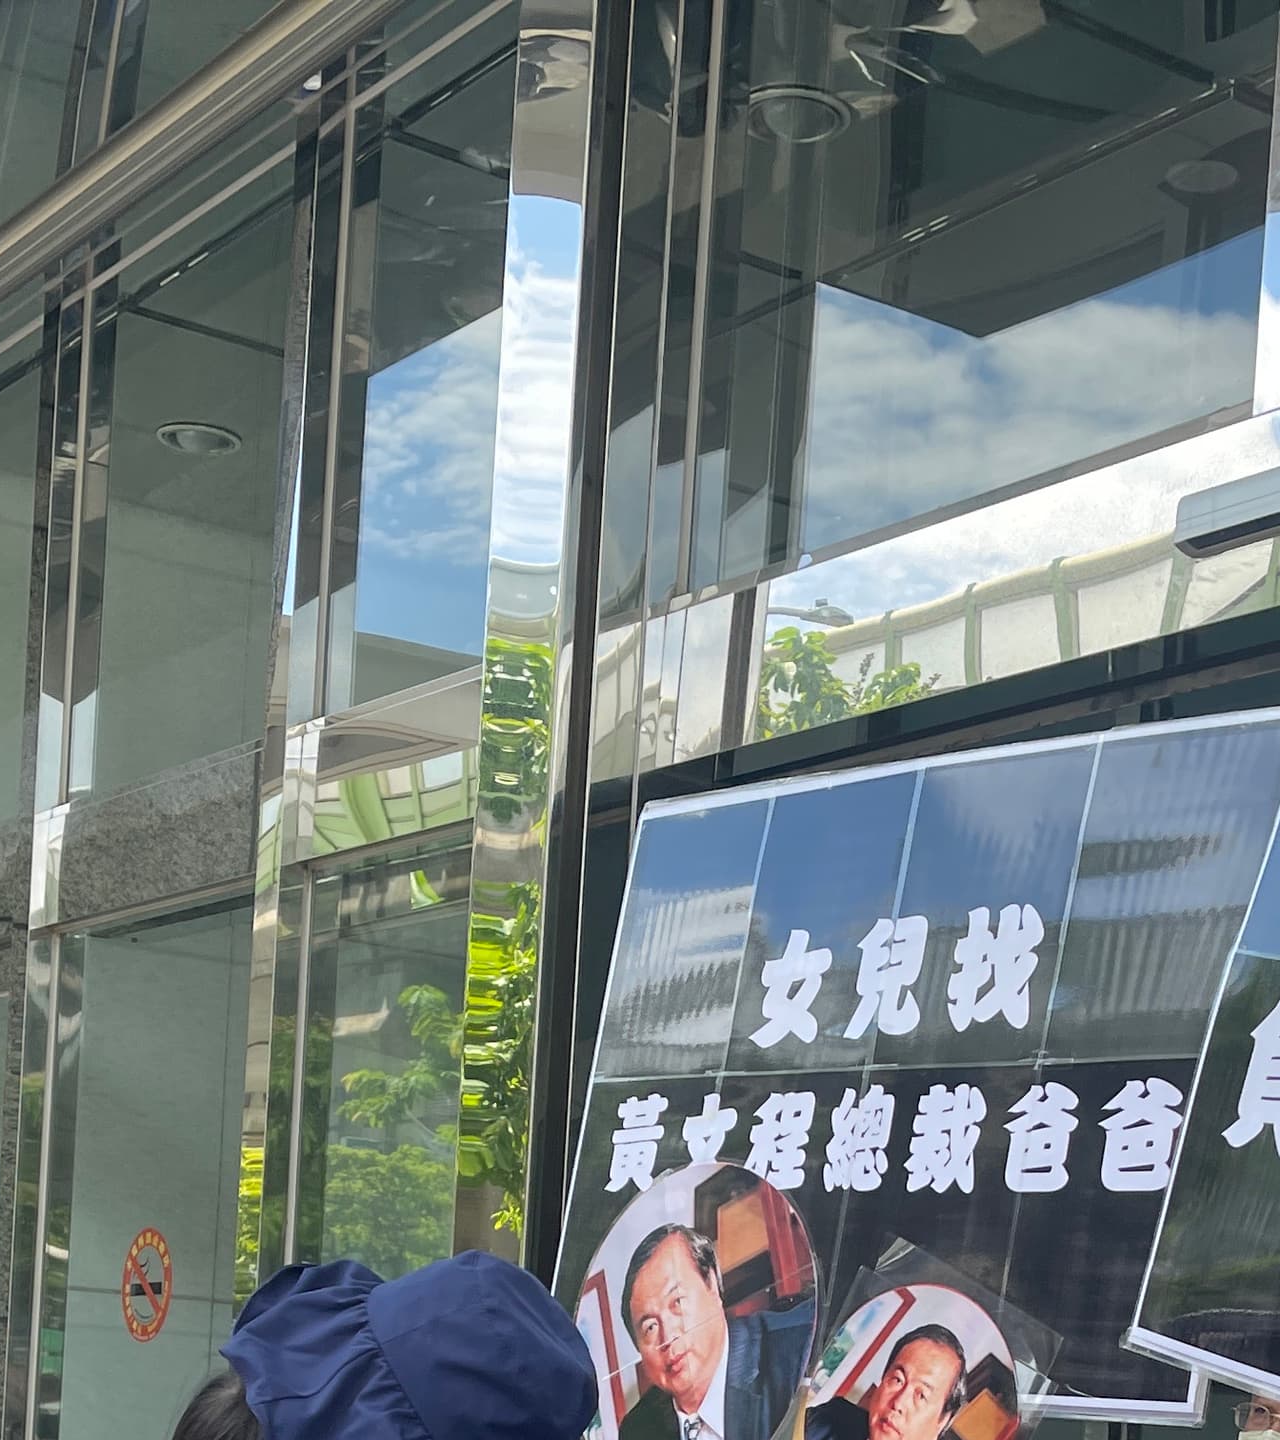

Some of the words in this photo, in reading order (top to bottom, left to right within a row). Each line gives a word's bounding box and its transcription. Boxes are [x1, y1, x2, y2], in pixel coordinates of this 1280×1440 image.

[749, 903, 1046, 1049] 女兒找
[603, 1077, 1184, 1195] 黃文程總裁爸爸
